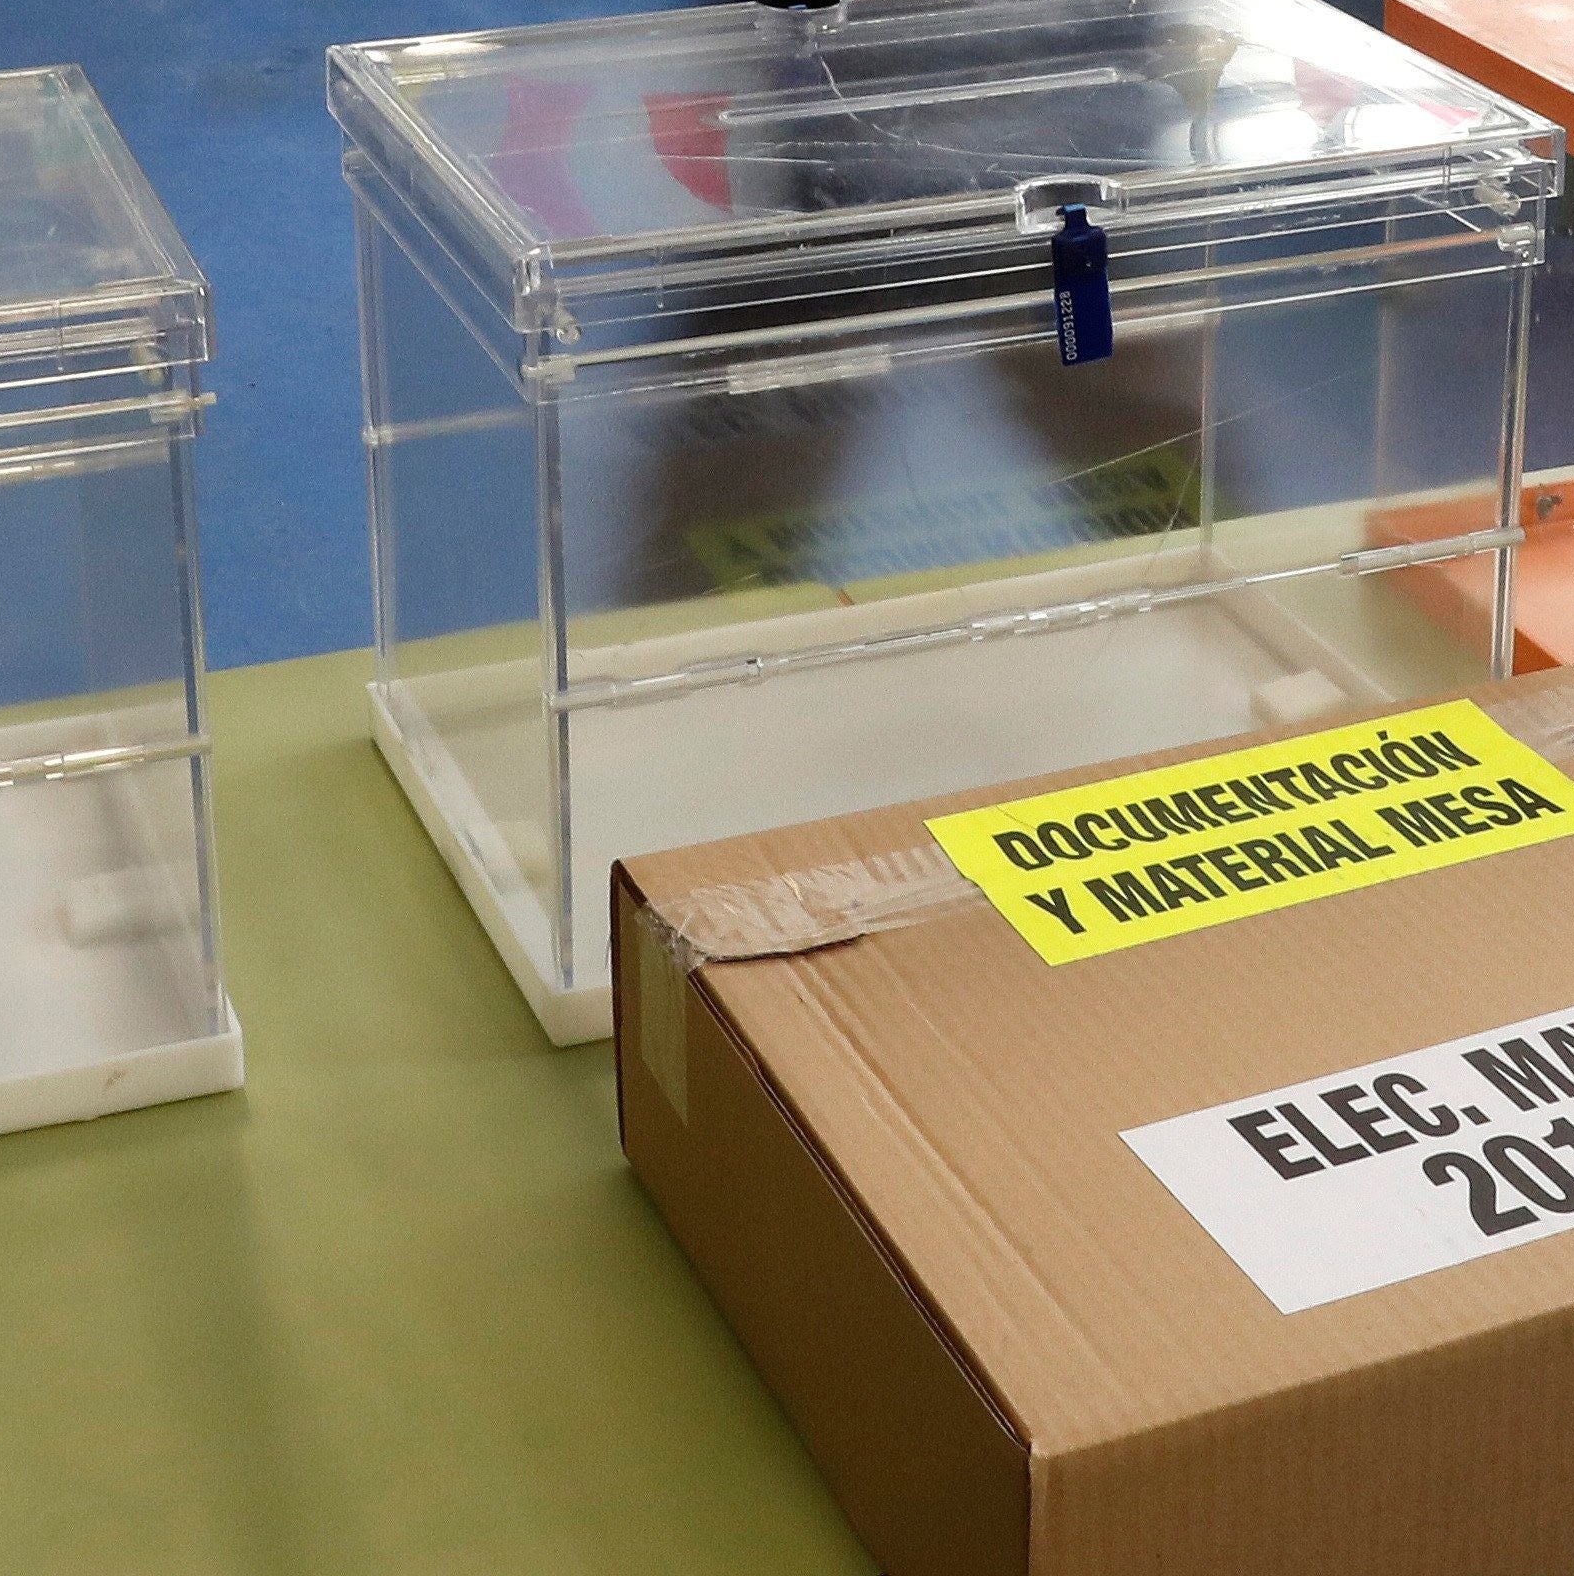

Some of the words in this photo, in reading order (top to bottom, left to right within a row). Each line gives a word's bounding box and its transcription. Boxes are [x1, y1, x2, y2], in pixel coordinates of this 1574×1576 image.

[993, 730, 1481, 872] DOCUMENTACIÓN
[1025, 887, 1086, 935] Y
[1082, 819, 1394, 923] MATERIAL
[1375, 777, 1564, 850] MESA
[1227, 1072, 1492, 1181] ELEC.
